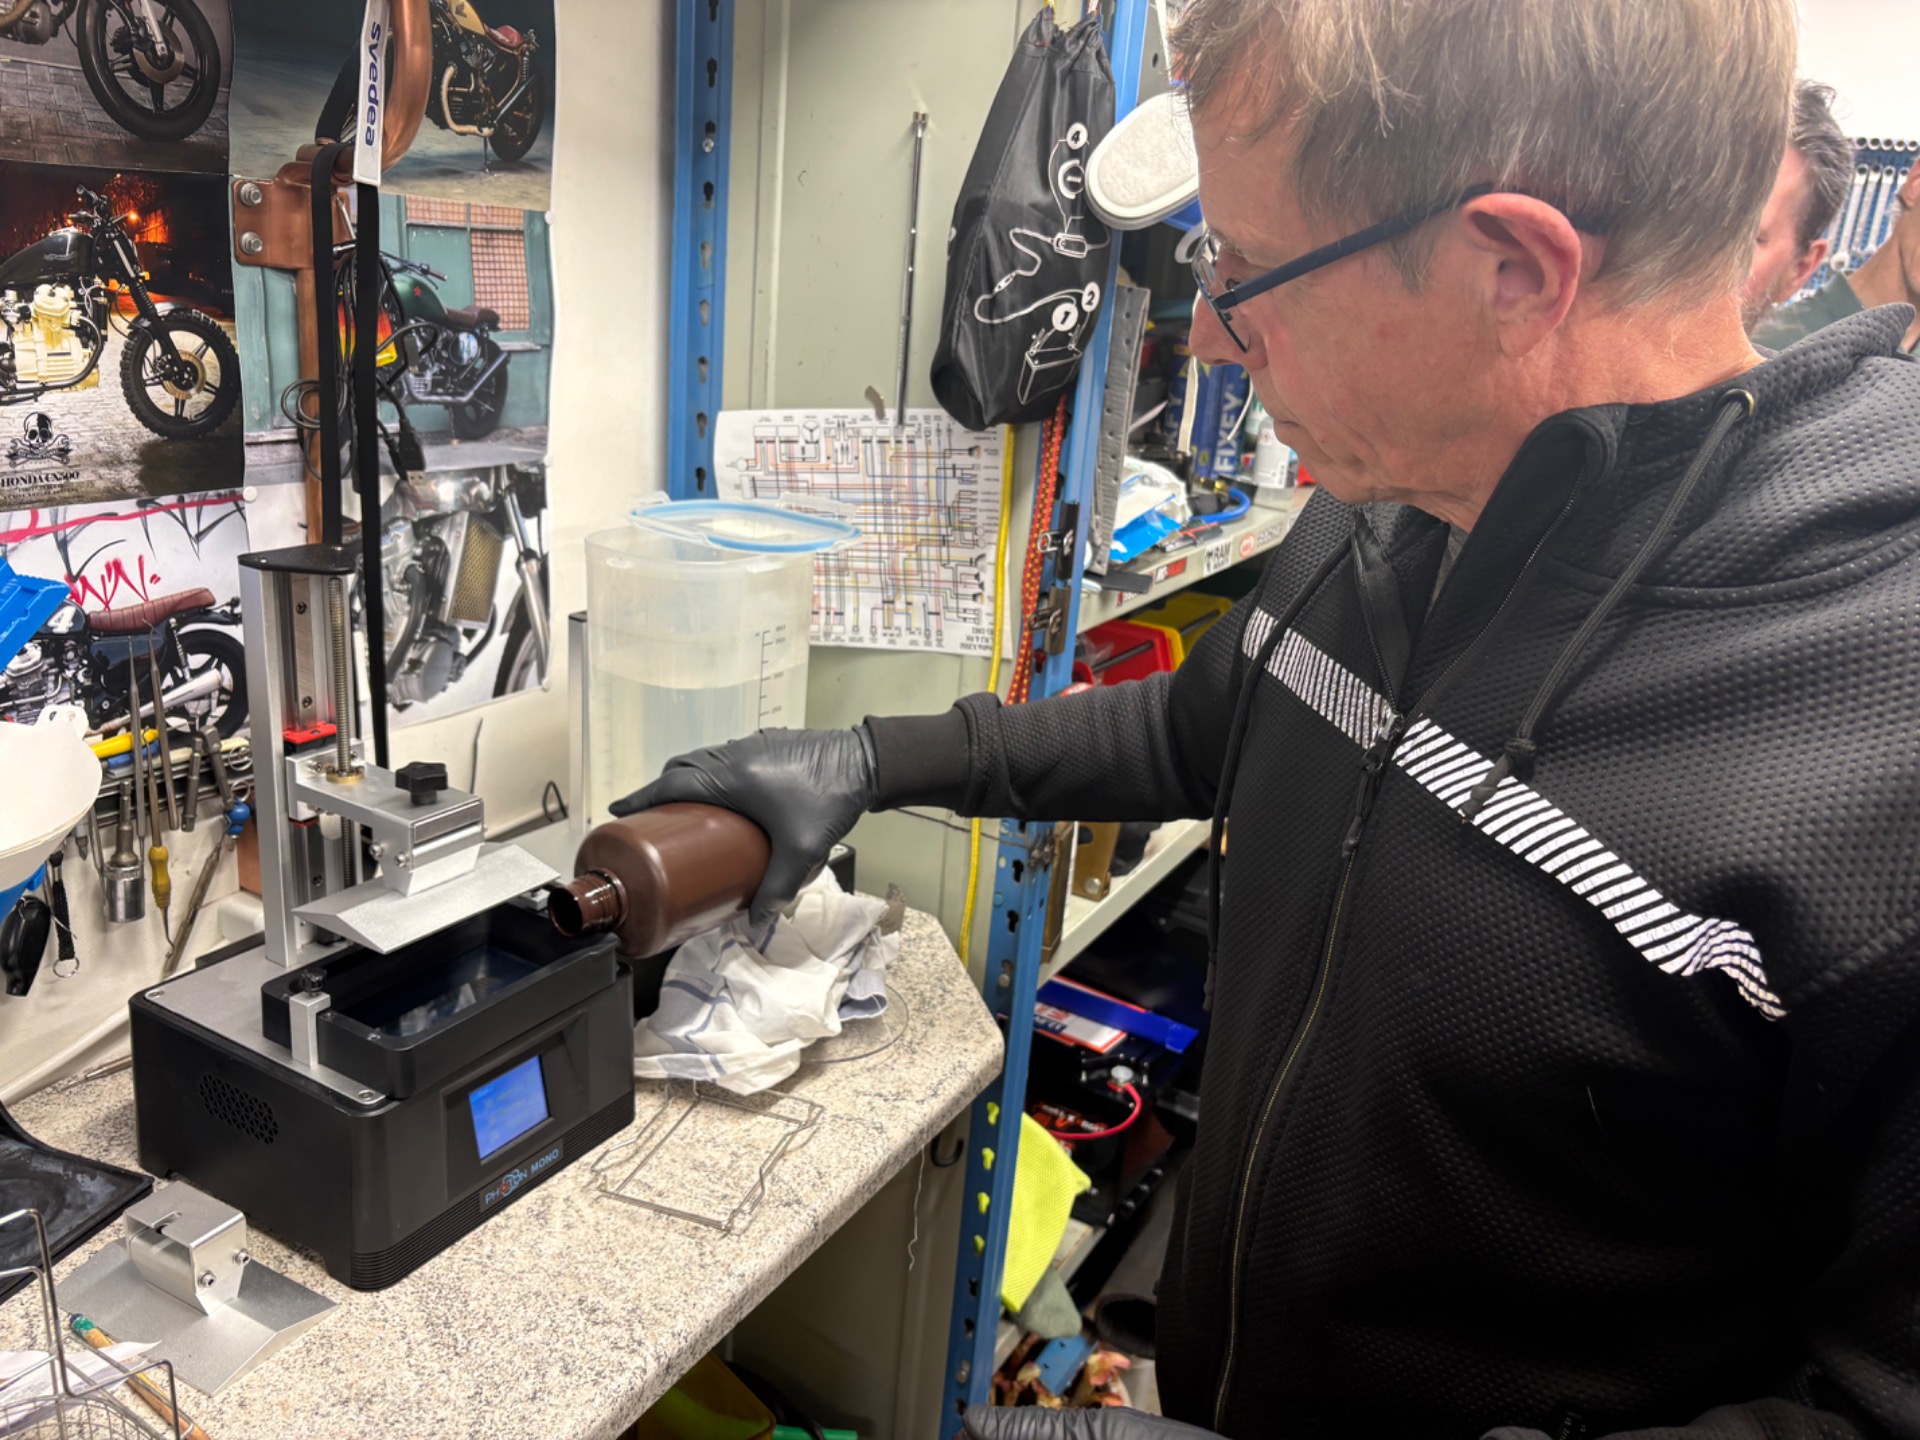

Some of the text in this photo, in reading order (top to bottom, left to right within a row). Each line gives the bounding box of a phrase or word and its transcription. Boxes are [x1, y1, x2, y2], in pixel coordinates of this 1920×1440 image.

[1071, 130, 1081, 144] 4
[1085, 290, 1096, 306] 2
[1060, 310, 1071, 325] 1
[1213, 391, 1243, 472] FIXEY
[1, 473, 45, 487] HONDA
[47, 605, 77, 634] 4
[531, 1149, 560, 1174] MONO
